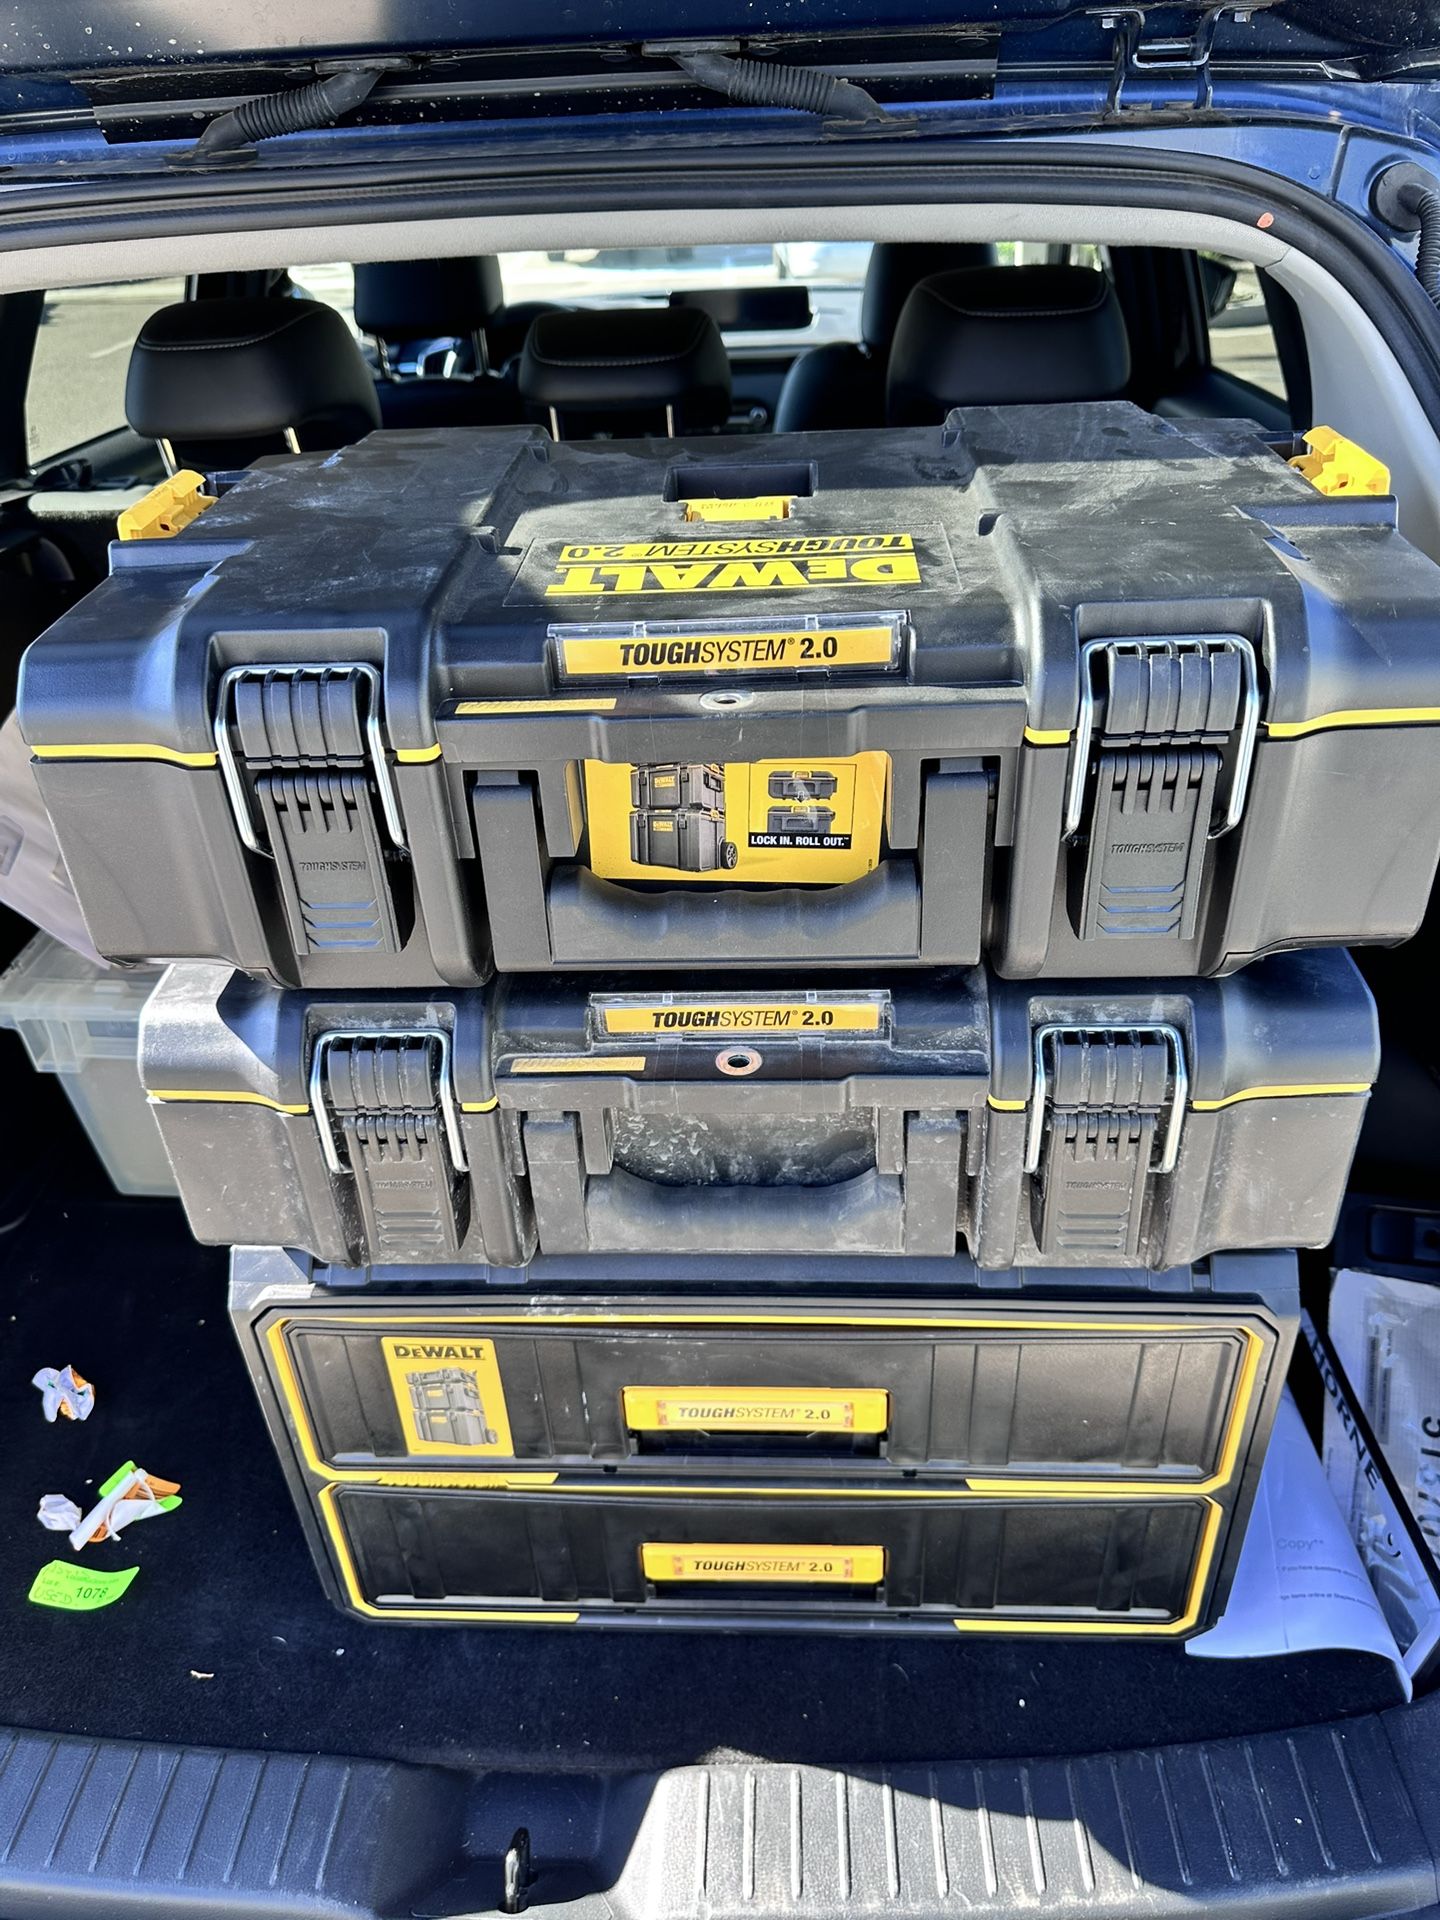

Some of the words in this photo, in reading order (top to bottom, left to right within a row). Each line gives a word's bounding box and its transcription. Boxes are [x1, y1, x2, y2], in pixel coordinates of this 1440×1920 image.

[568, 545, 626, 559] 2.0
[800, 636, 838, 659] 2.0
[751, 835, 777, 845] LOCK
[780, 836, 793, 845] IN.
[795, 836, 820, 846] ROLL
[801, 1010, 834, 1027] 2.0
[804, 1409, 831, 1420] 2.0
[808, 1562, 833, 1573] 2.0
